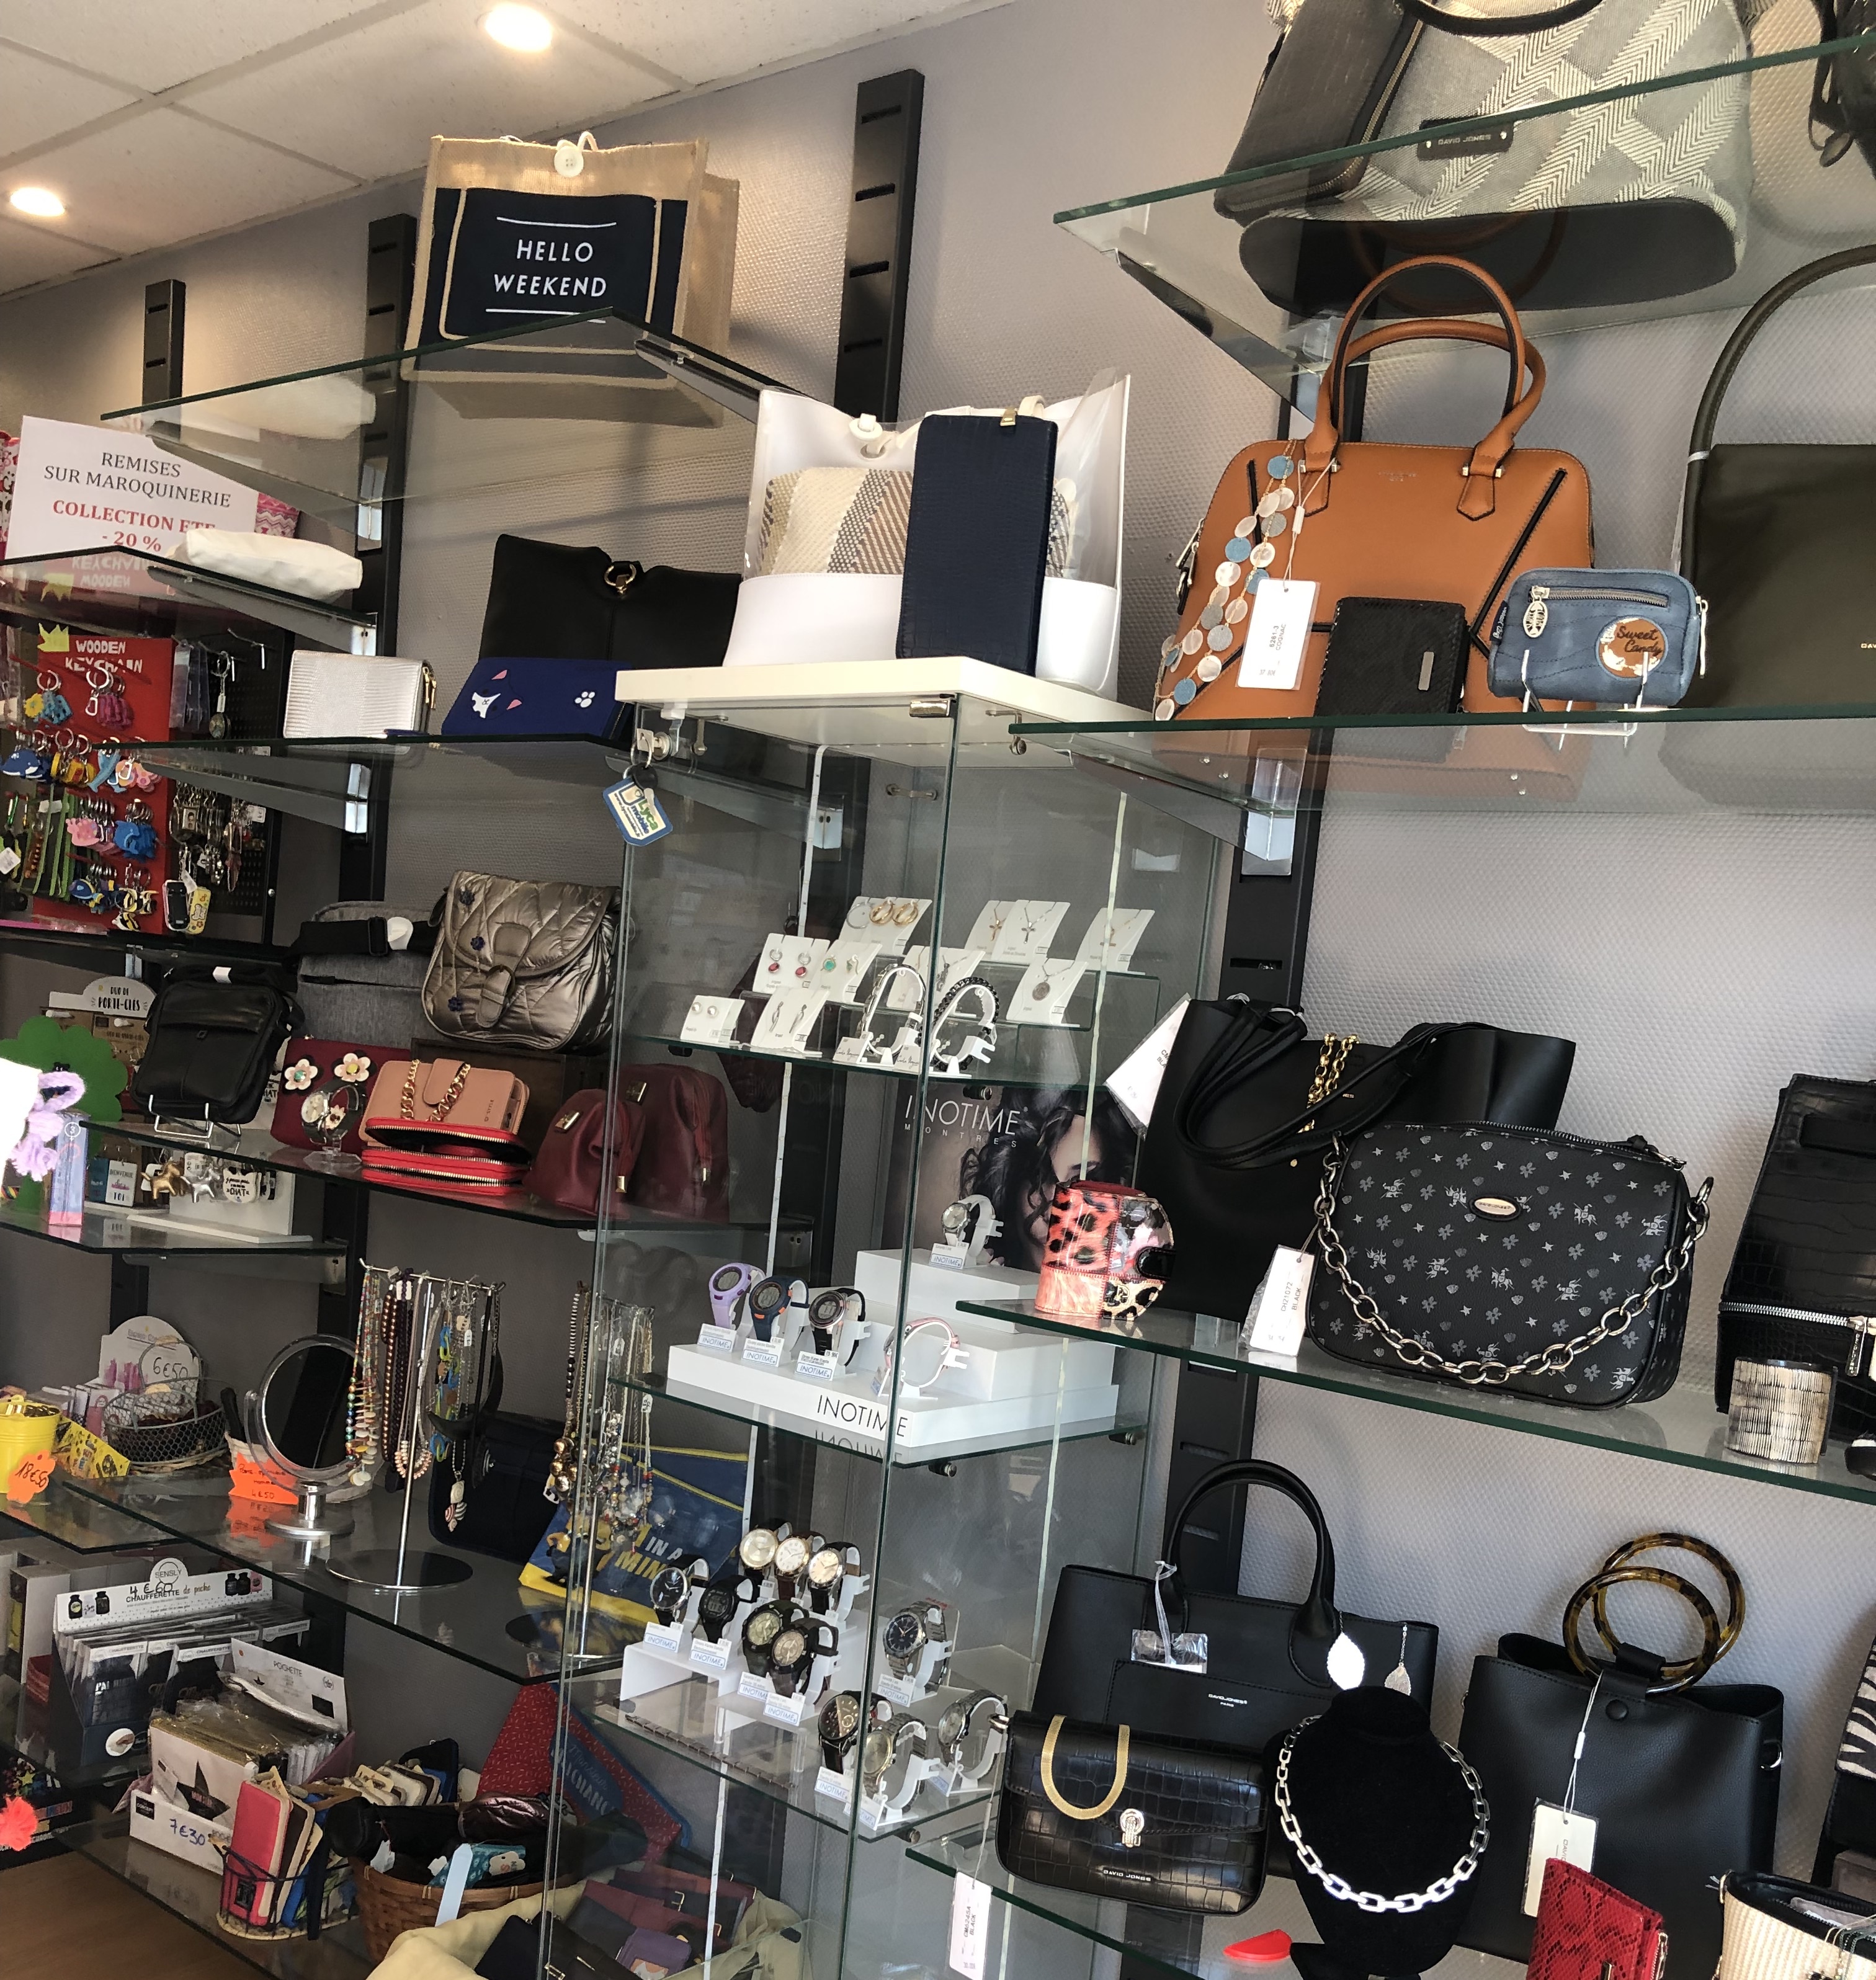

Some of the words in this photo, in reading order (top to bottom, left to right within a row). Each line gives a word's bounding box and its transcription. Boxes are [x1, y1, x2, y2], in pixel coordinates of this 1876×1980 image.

[1437, 137, 1460, 146] DAVID
[1462, 133, 1491, 143] JONES
[516, 239, 593, 262] HELLO
[494, 274, 607, 297] WEEKEND
[101, 452, 181, 478] REMISES
[44, 465, 80, 484] SUR
[86, 471, 231, 508] MAROQUINERIE
[53, 499, 174, 531] COLLECTION
[114, 531, 137, 547] 20
[1275, 623, 1287, 651] COGNAC
[1617, 625, 1659, 640] Sweet
[75, 640, 126, 654] WOODEN
[1624, 639, 1663, 657] Candy
[638, 798, 659, 831] Lyca
[1156, 1056, 1167, 1069] BLA
[905, 1095, 1021, 1135] INOTIME
[904, 1123, 1017, 1148] MONTRES
[230, 1187, 246, 1197] CHAT
[1280, 1282, 1293, 1311] CH21072
[1291, 1288, 1302, 1311] BLACK
[817, 1394, 908, 1437] INOTIME
[645, 1536, 669, 1556] IN
[667, 1547, 683, 1561] A
[155, 1569, 182, 1578] SENSLY
[614, 1551, 668, 1581] MIN
[126, 1589, 180, 1603] CHAUFFERETTE
[274, 1661, 303, 1677] POCHETTE
